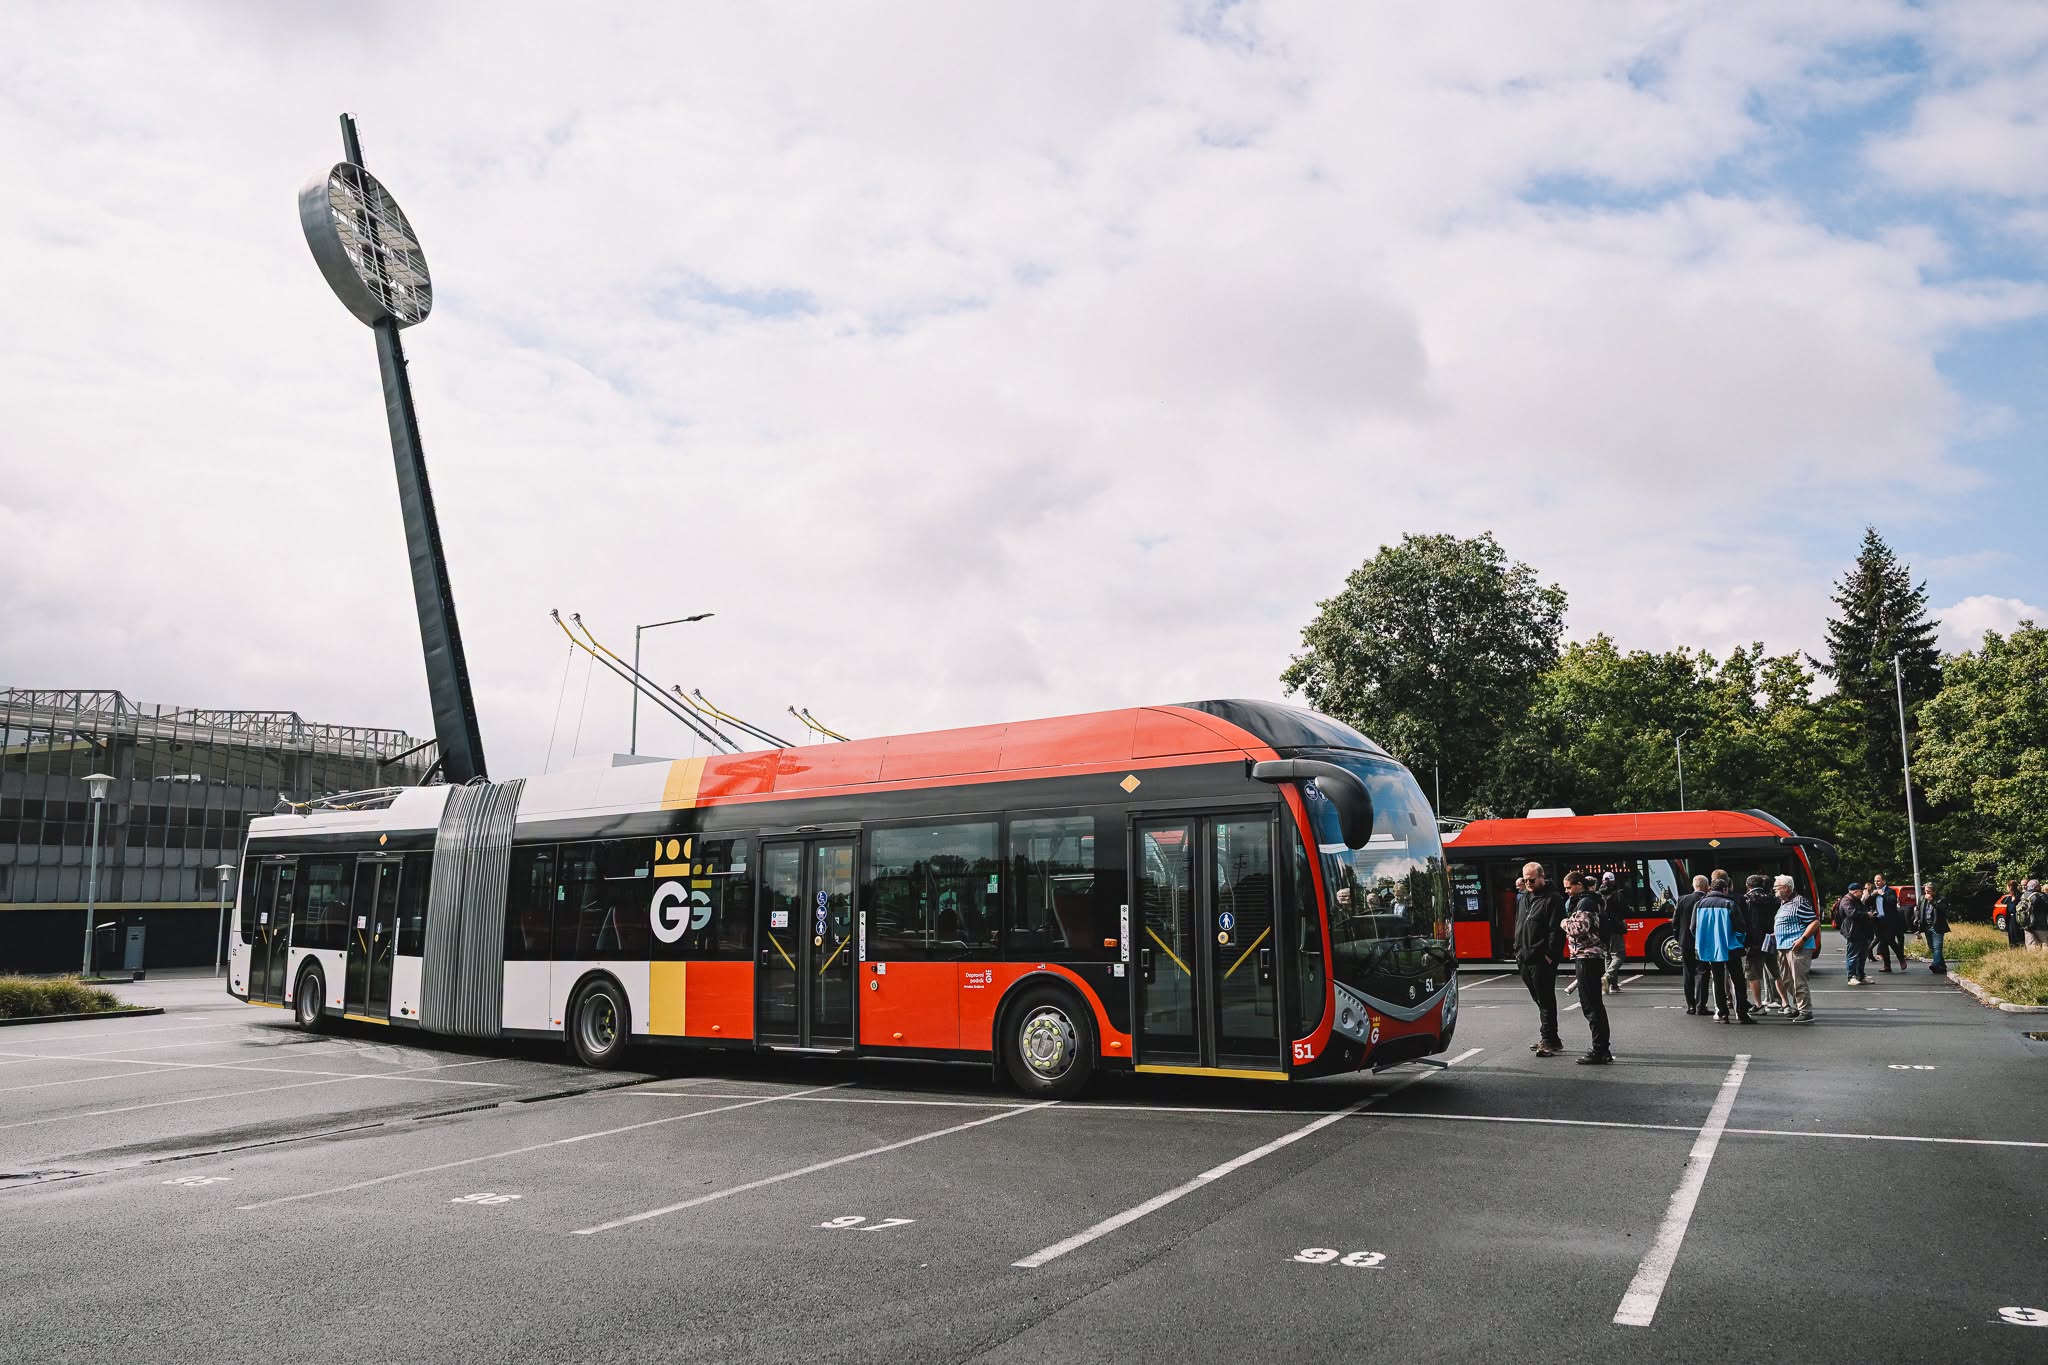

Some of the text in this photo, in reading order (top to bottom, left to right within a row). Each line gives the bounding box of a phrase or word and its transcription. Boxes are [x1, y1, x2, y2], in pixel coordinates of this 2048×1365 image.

[650, 880, 690, 943] G
[1425, 978, 1435, 992] 51
[1294, 1043, 1314, 1059] 51
[819, 1215, 916, 1231] 97
[1291, 1247, 1386, 1269] 98
